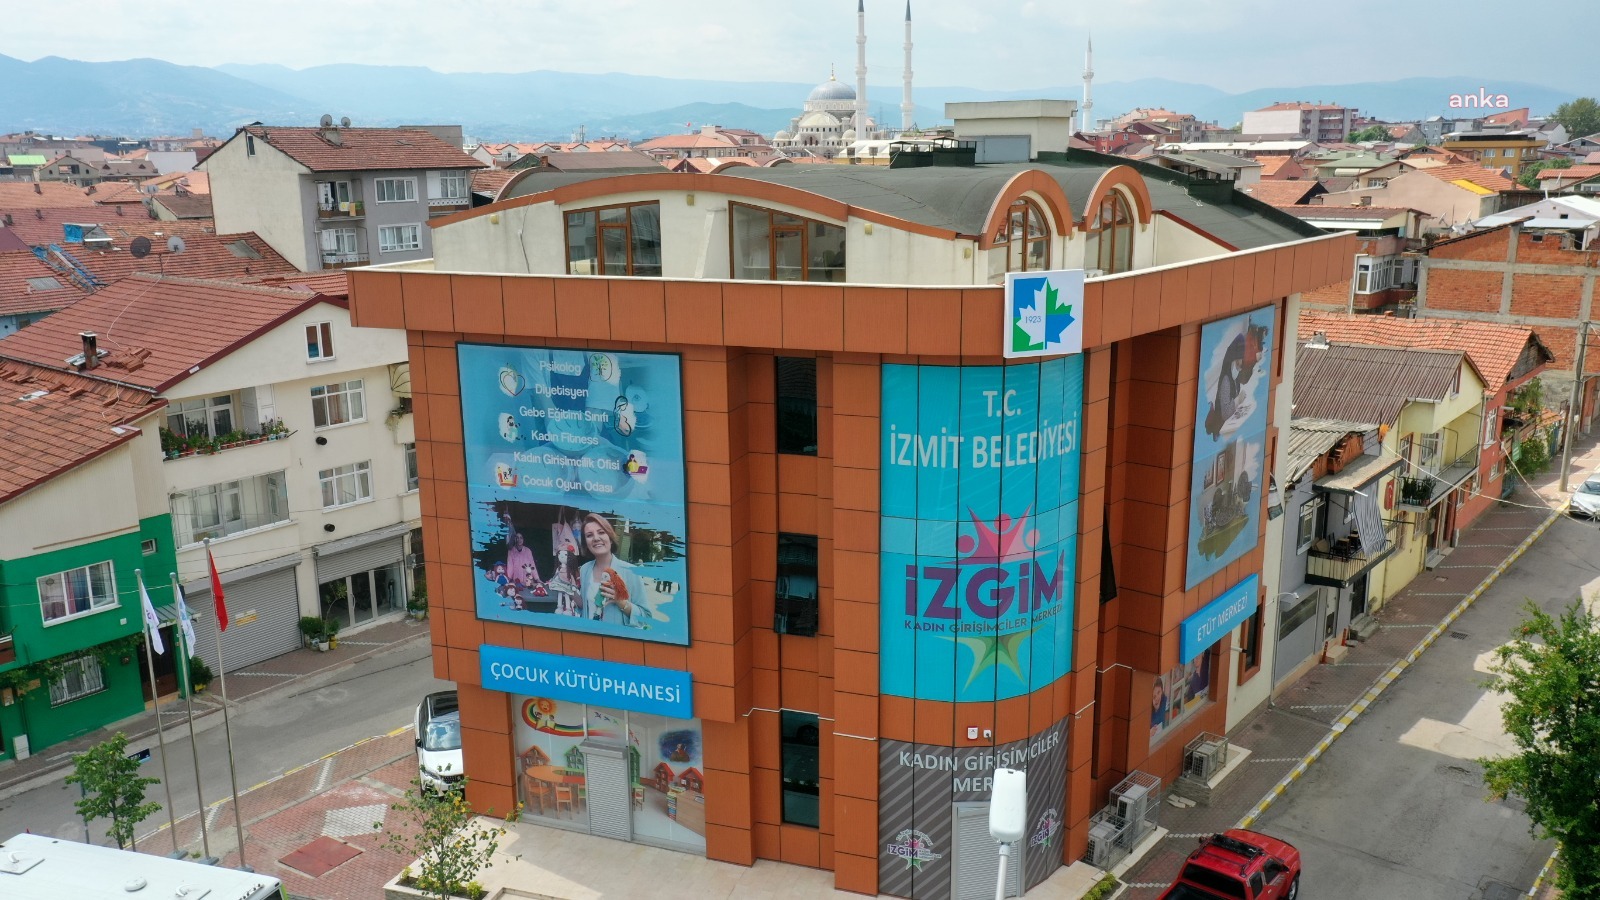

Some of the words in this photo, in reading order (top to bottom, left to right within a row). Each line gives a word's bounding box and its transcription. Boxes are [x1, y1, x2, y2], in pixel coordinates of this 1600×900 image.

[1025, 315, 1042, 324] 1923
[539, 360, 582, 376] Psikolog
[535, 383, 589, 398] Diyetisyen
[519, 405, 546, 419] Gebe
[584, 410, 609, 423] Sınıfı
[982, 389, 1022, 418] T.C.
[531, 430, 559, 442] Kadın
[560, 432, 599, 446] Fitness
[890, 424, 965, 469] İZMİT
[972, 411, 1077, 469] BELEDİYESİ
[513, 451, 541, 464] Kadın
[542, 453, 595, 469] Girişimcilik
[596, 458, 620, 472] Ofisi
[522, 475, 554, 489] Çocuk
[555, 477, 582, 491] Oyun
[583, 480, 613, 493] Odası
[905, 549, 1066, 620] İZGİM
[904, 619, 945, 633] KADIN
[949, 617, 1027, 635] GİRİŞİMCİLER
[1031, 601, 1064, 623] MERKEZİ
[1197, 617, 1217, 642] ETÜT
[1217, 592, 1248, 628] MERKEZİ
[490, 661, 549, 685] ÇOCUK
[554, 669, 681, 704] KÜTÜPHANESİ
[900, 751, 958, 772] KADIN
[964, 731, 1060, 771] GİRİŞİMCİLER
